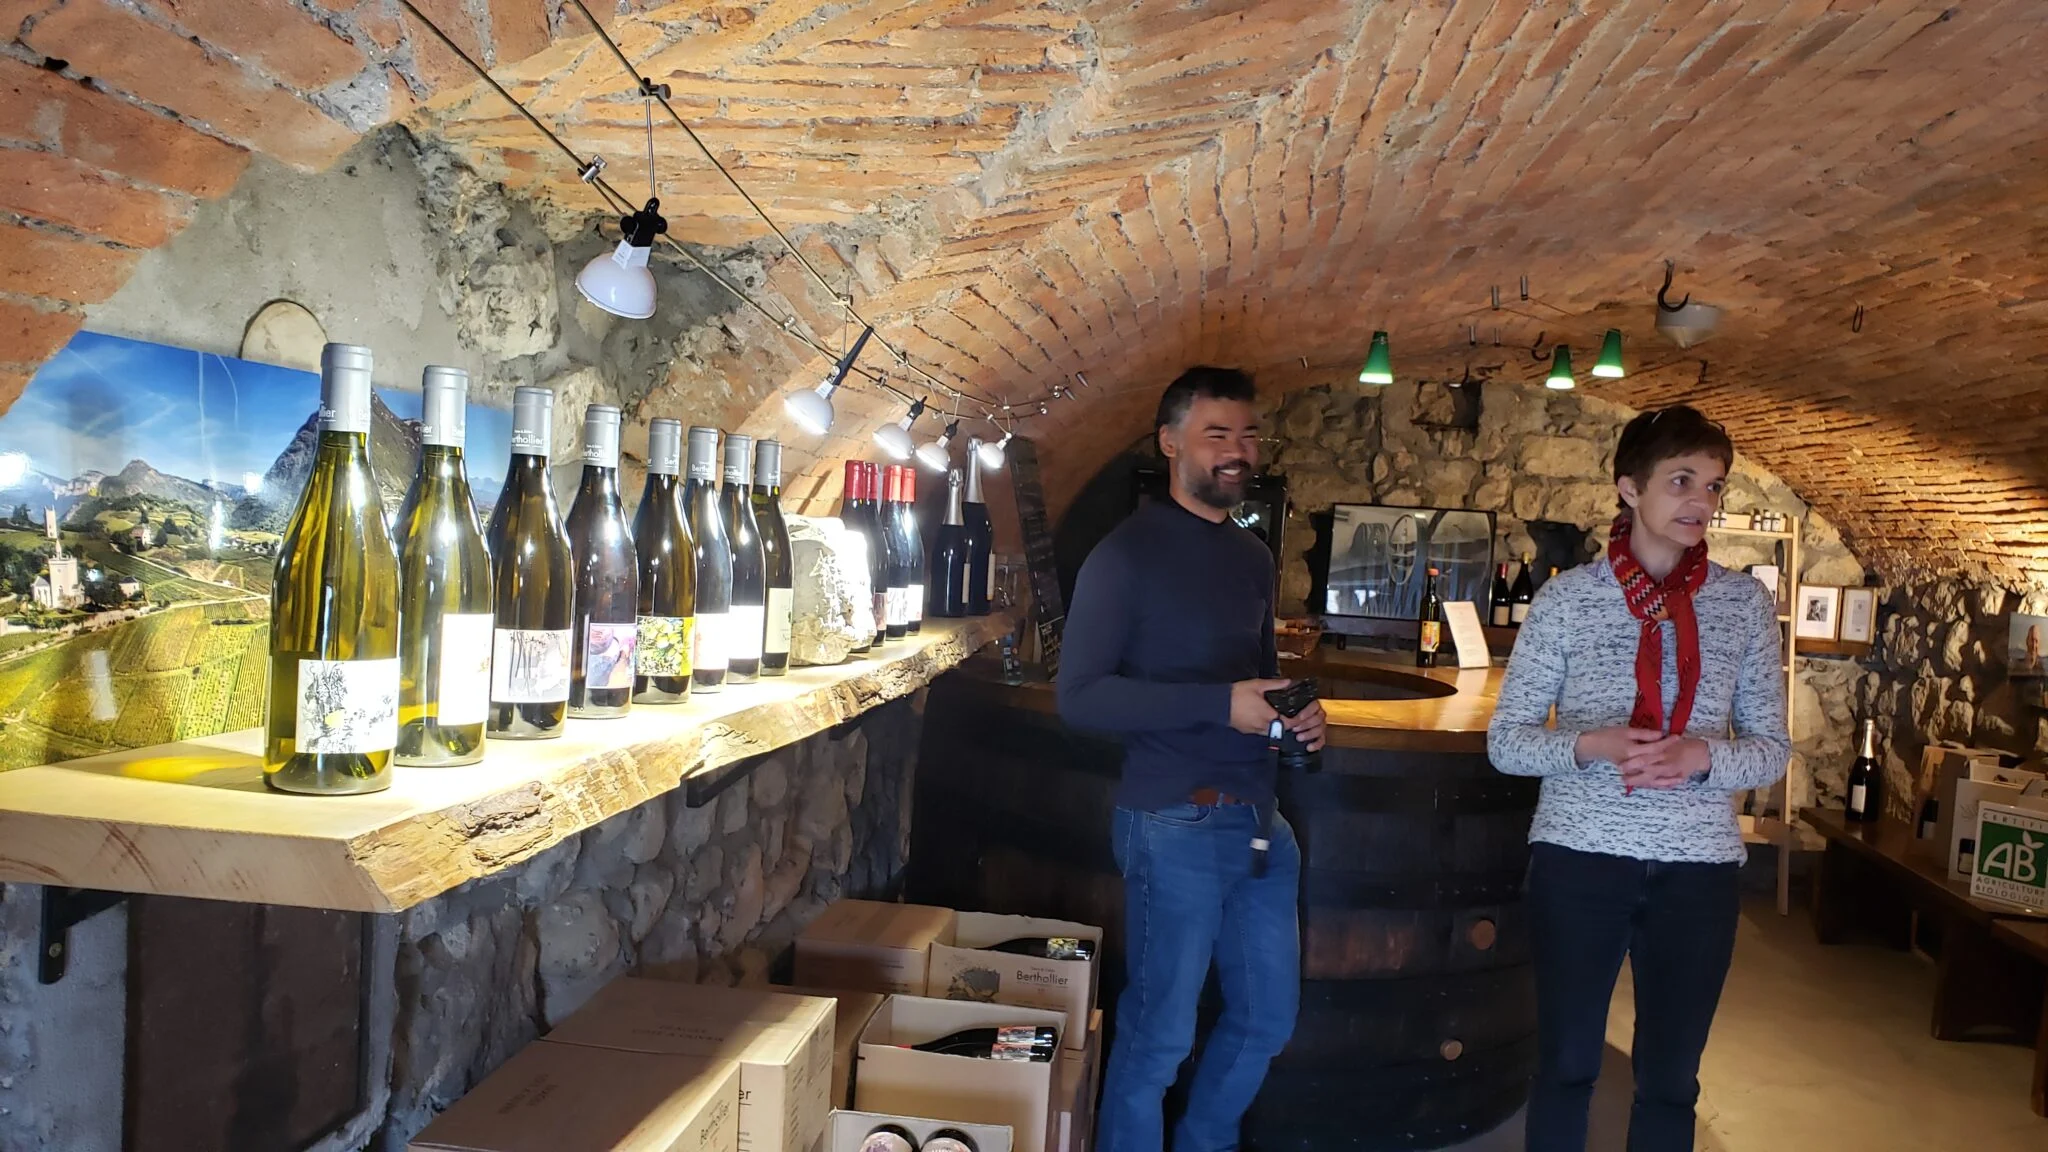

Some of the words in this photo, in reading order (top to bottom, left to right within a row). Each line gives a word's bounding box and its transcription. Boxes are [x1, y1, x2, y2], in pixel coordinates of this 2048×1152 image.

[1982, 841, 2038, 882] AB
[1975, 884, 2044, 905] BIOLOGIQUE
[1016, 970, 1069, 985] Berthollier
